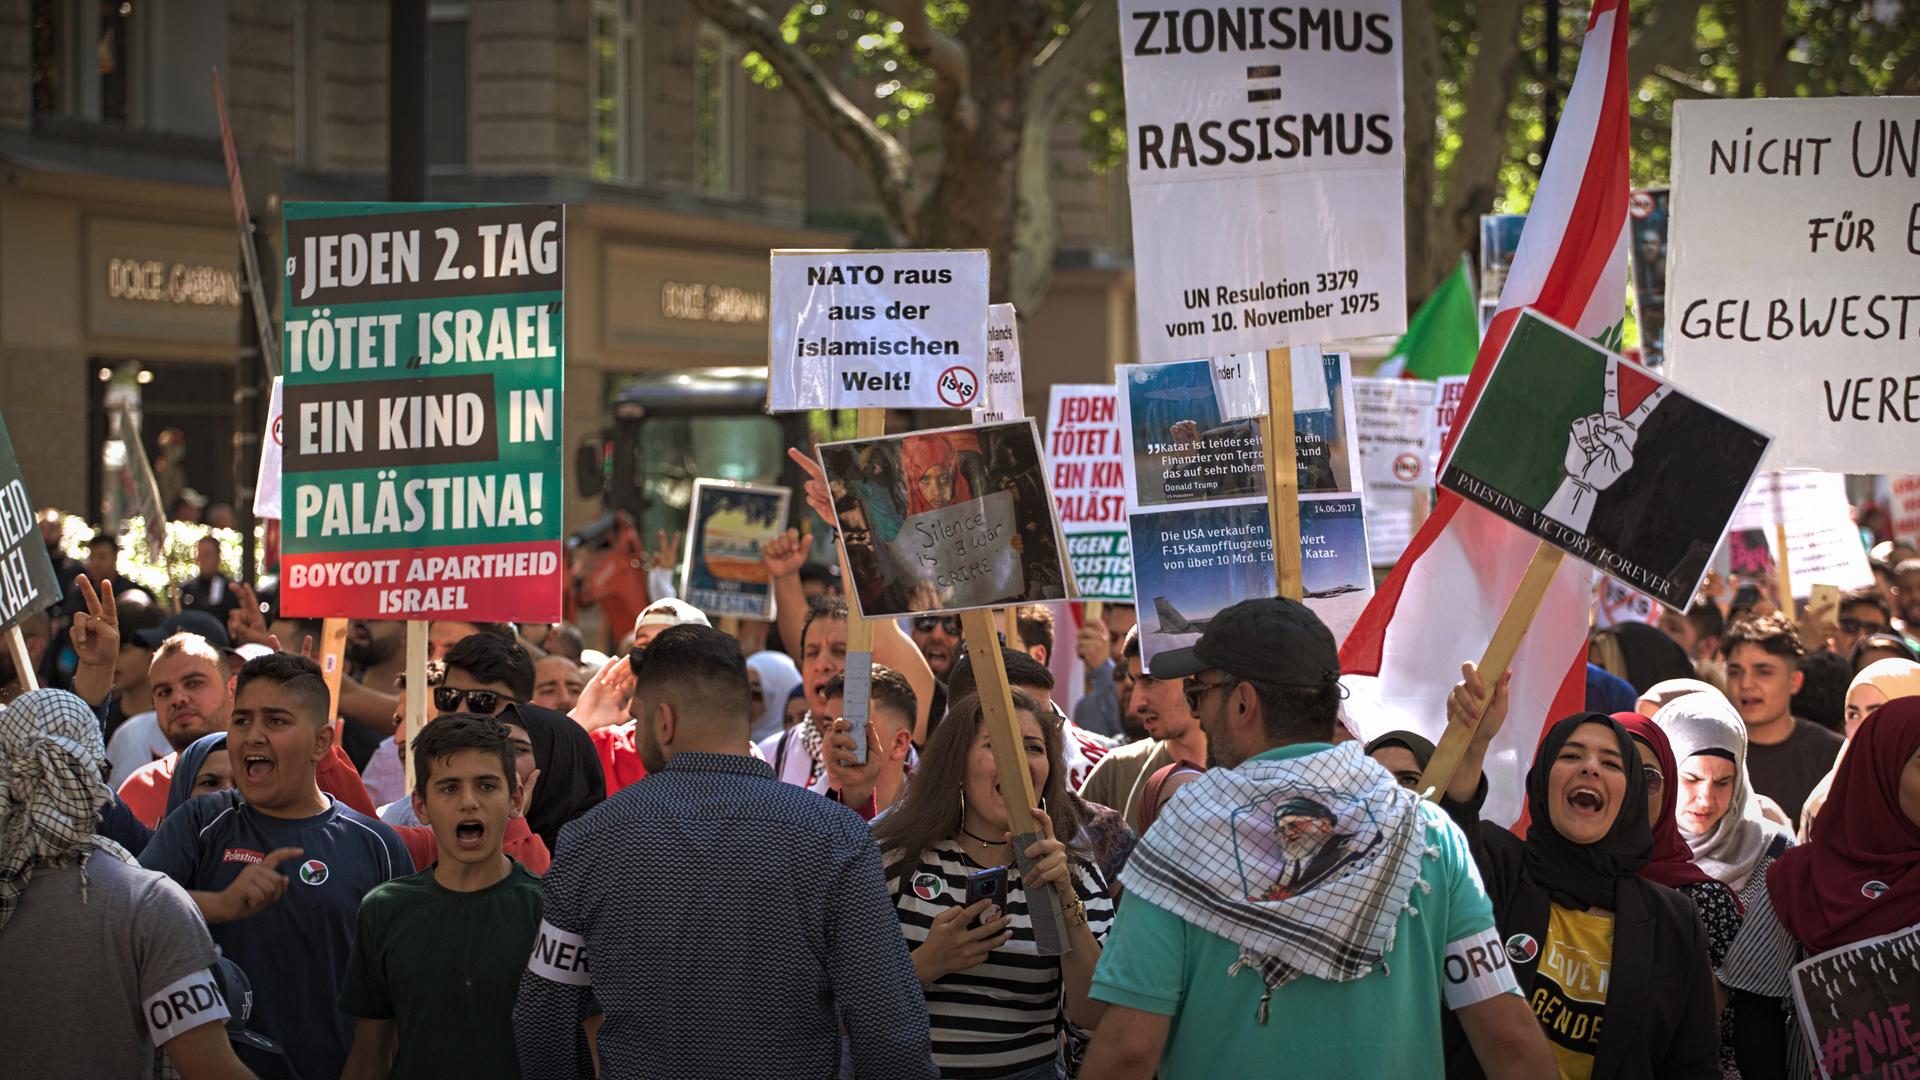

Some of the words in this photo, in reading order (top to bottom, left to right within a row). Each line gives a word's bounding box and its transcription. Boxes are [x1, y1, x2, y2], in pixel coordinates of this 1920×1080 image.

[1132, 8, 1393, 56] ZIONISMUS
[1138, 113, 1393, 170] RASSISMUS
[1809, 210, 1875, 253] FÜR
[301, 230, 420, 300] JEDEN
[807, 265, 884, 286] NATO
[894, 268, 952, 284] raus
[1184, 288, 1209, 309] UN
[1316, 269, 1358, 293] 3379
[828, 304, 876, 320] aus
[885, 301, 930, 320] der
[1166, 317, 1204, 337] vom
[1211, 312, 1237, 332] 10.
[1244, 301, 1333, 328] November
[1340, 293, 1379, 314] 1975
[285, 308, 402, 373] TÖTET
[798, 336, 959, 357] islamischen
[842, 371, 911, 391] Welt!
[300, 399, 363, 455] EIN
[379, 392, 484, 451] KIND
[509, 388, 553, 443] IN
[1058, 396, 1116, 427] JEDEN
[1052, 425, 1108, 457] TÖTET
[1161, 453, 1212, 466] Finanzier
[1214, 452, 1234, 463] von
[1302, 446, 1322, 457] und
[1192, 440, 1206, 450] ist
[1209, 438, 1242, 450] leider
[1304, 433, 1321, 443] ein
[1054, 462, 1085, 489] EIN
[1162, 467, 1181, 480] das
[1184, 466, 1202, 477] auf
[1204, 463, 1228, 476] sehr
[1230, 461, 1265, 475] hohem
[1165, 482, 1192, 492] Donald
[1194, 481, 1218, 490] Trump
[295, 469, 543, 538] PALÄSTINA!
[1314, 503, 1356, 514] 14.06.2017
[915, 514, 984, 548] Silence
[916, 553, 938, 567] is
[972, 524, 1002, 548] war
[1161, 530, 1180, 542] Die
[1183, 527, 1205, 540] USA
[1206, 524, 1264, 538] verkaufen
[1458, 474, 1525, 518] PALESTINE
[1531, 512, 1595, 554] VICTORY
[1599, 548, 1671, 595] FOREVER
[289, 559, 400, 588] BOYCOTT
[406, 550, 557, 583] APARTHEID
[937, 558, 992, 587] CRIME
[1163, 560, 1184, 570] von
[1187, 556, 1213, 568] über
[1217, 555, 1230, 566] 10
[1232, 553, 1258, 565] Mrd.
[1305, 548, 1338, 560] Katar.
[378, 586, 468, 614] ISRAEL
[1444, 939, 1506, 984] ORD
